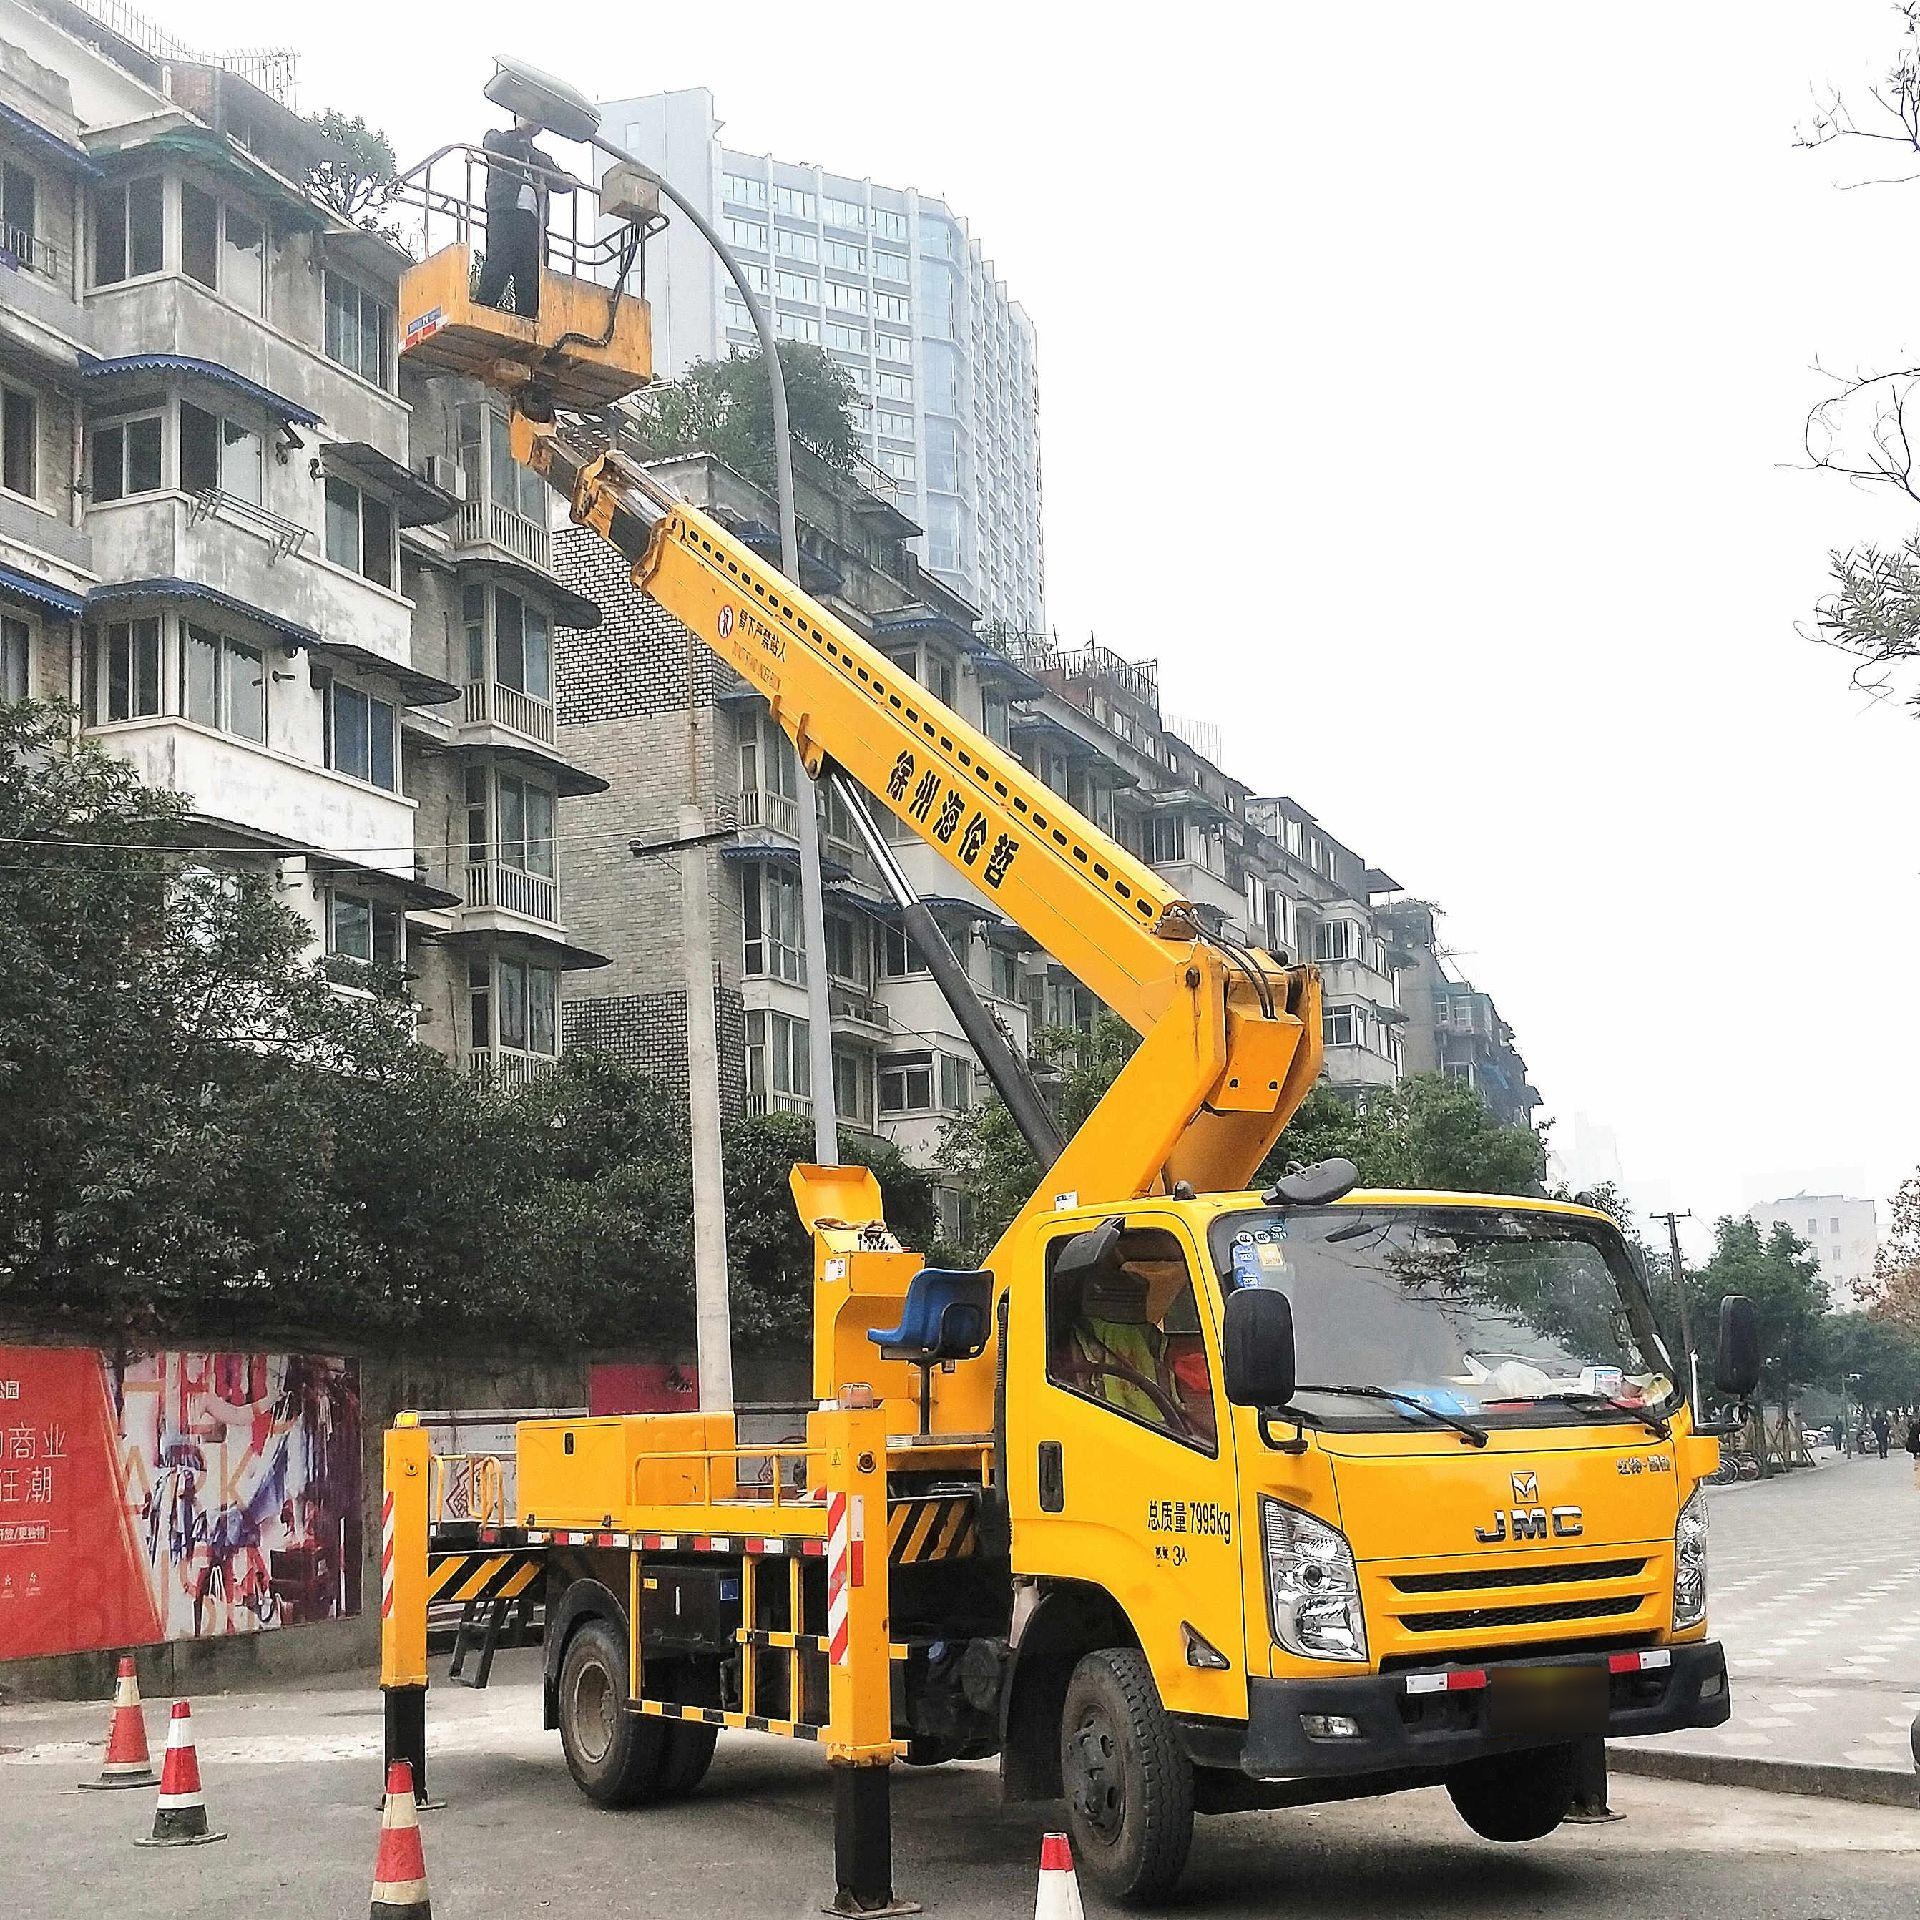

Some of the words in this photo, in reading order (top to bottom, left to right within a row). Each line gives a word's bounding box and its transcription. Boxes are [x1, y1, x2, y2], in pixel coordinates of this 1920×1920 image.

[886, 749, 1020, 889] 徐州海伦哲
[0, 1421, 68, 1460] 商业
[1474, 1505, 1584, 1543] JMC
